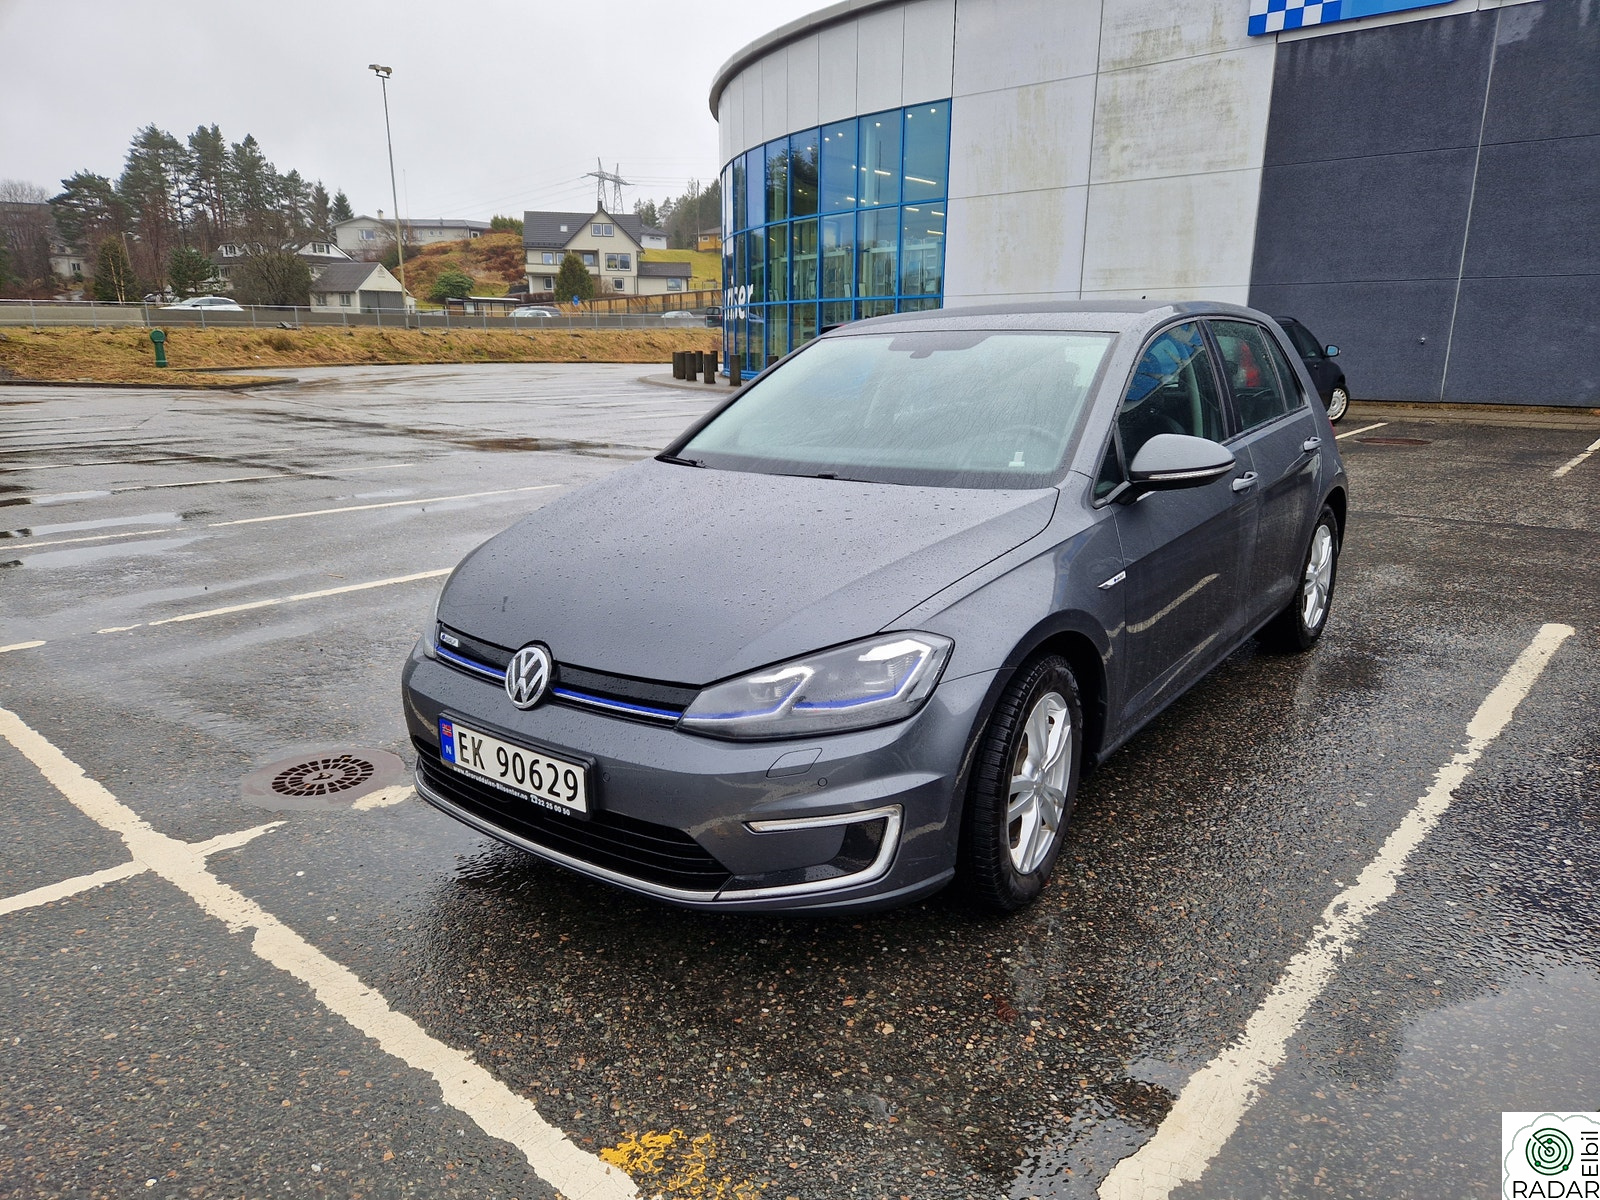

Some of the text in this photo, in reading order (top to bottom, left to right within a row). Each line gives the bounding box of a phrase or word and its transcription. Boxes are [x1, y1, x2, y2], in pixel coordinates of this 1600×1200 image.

[445, 745, 452, 755] N
[458, 731, 578, 802] EK 90629
[537, 798, 546, 807] 22
[554, 804, 562, 813] 00
